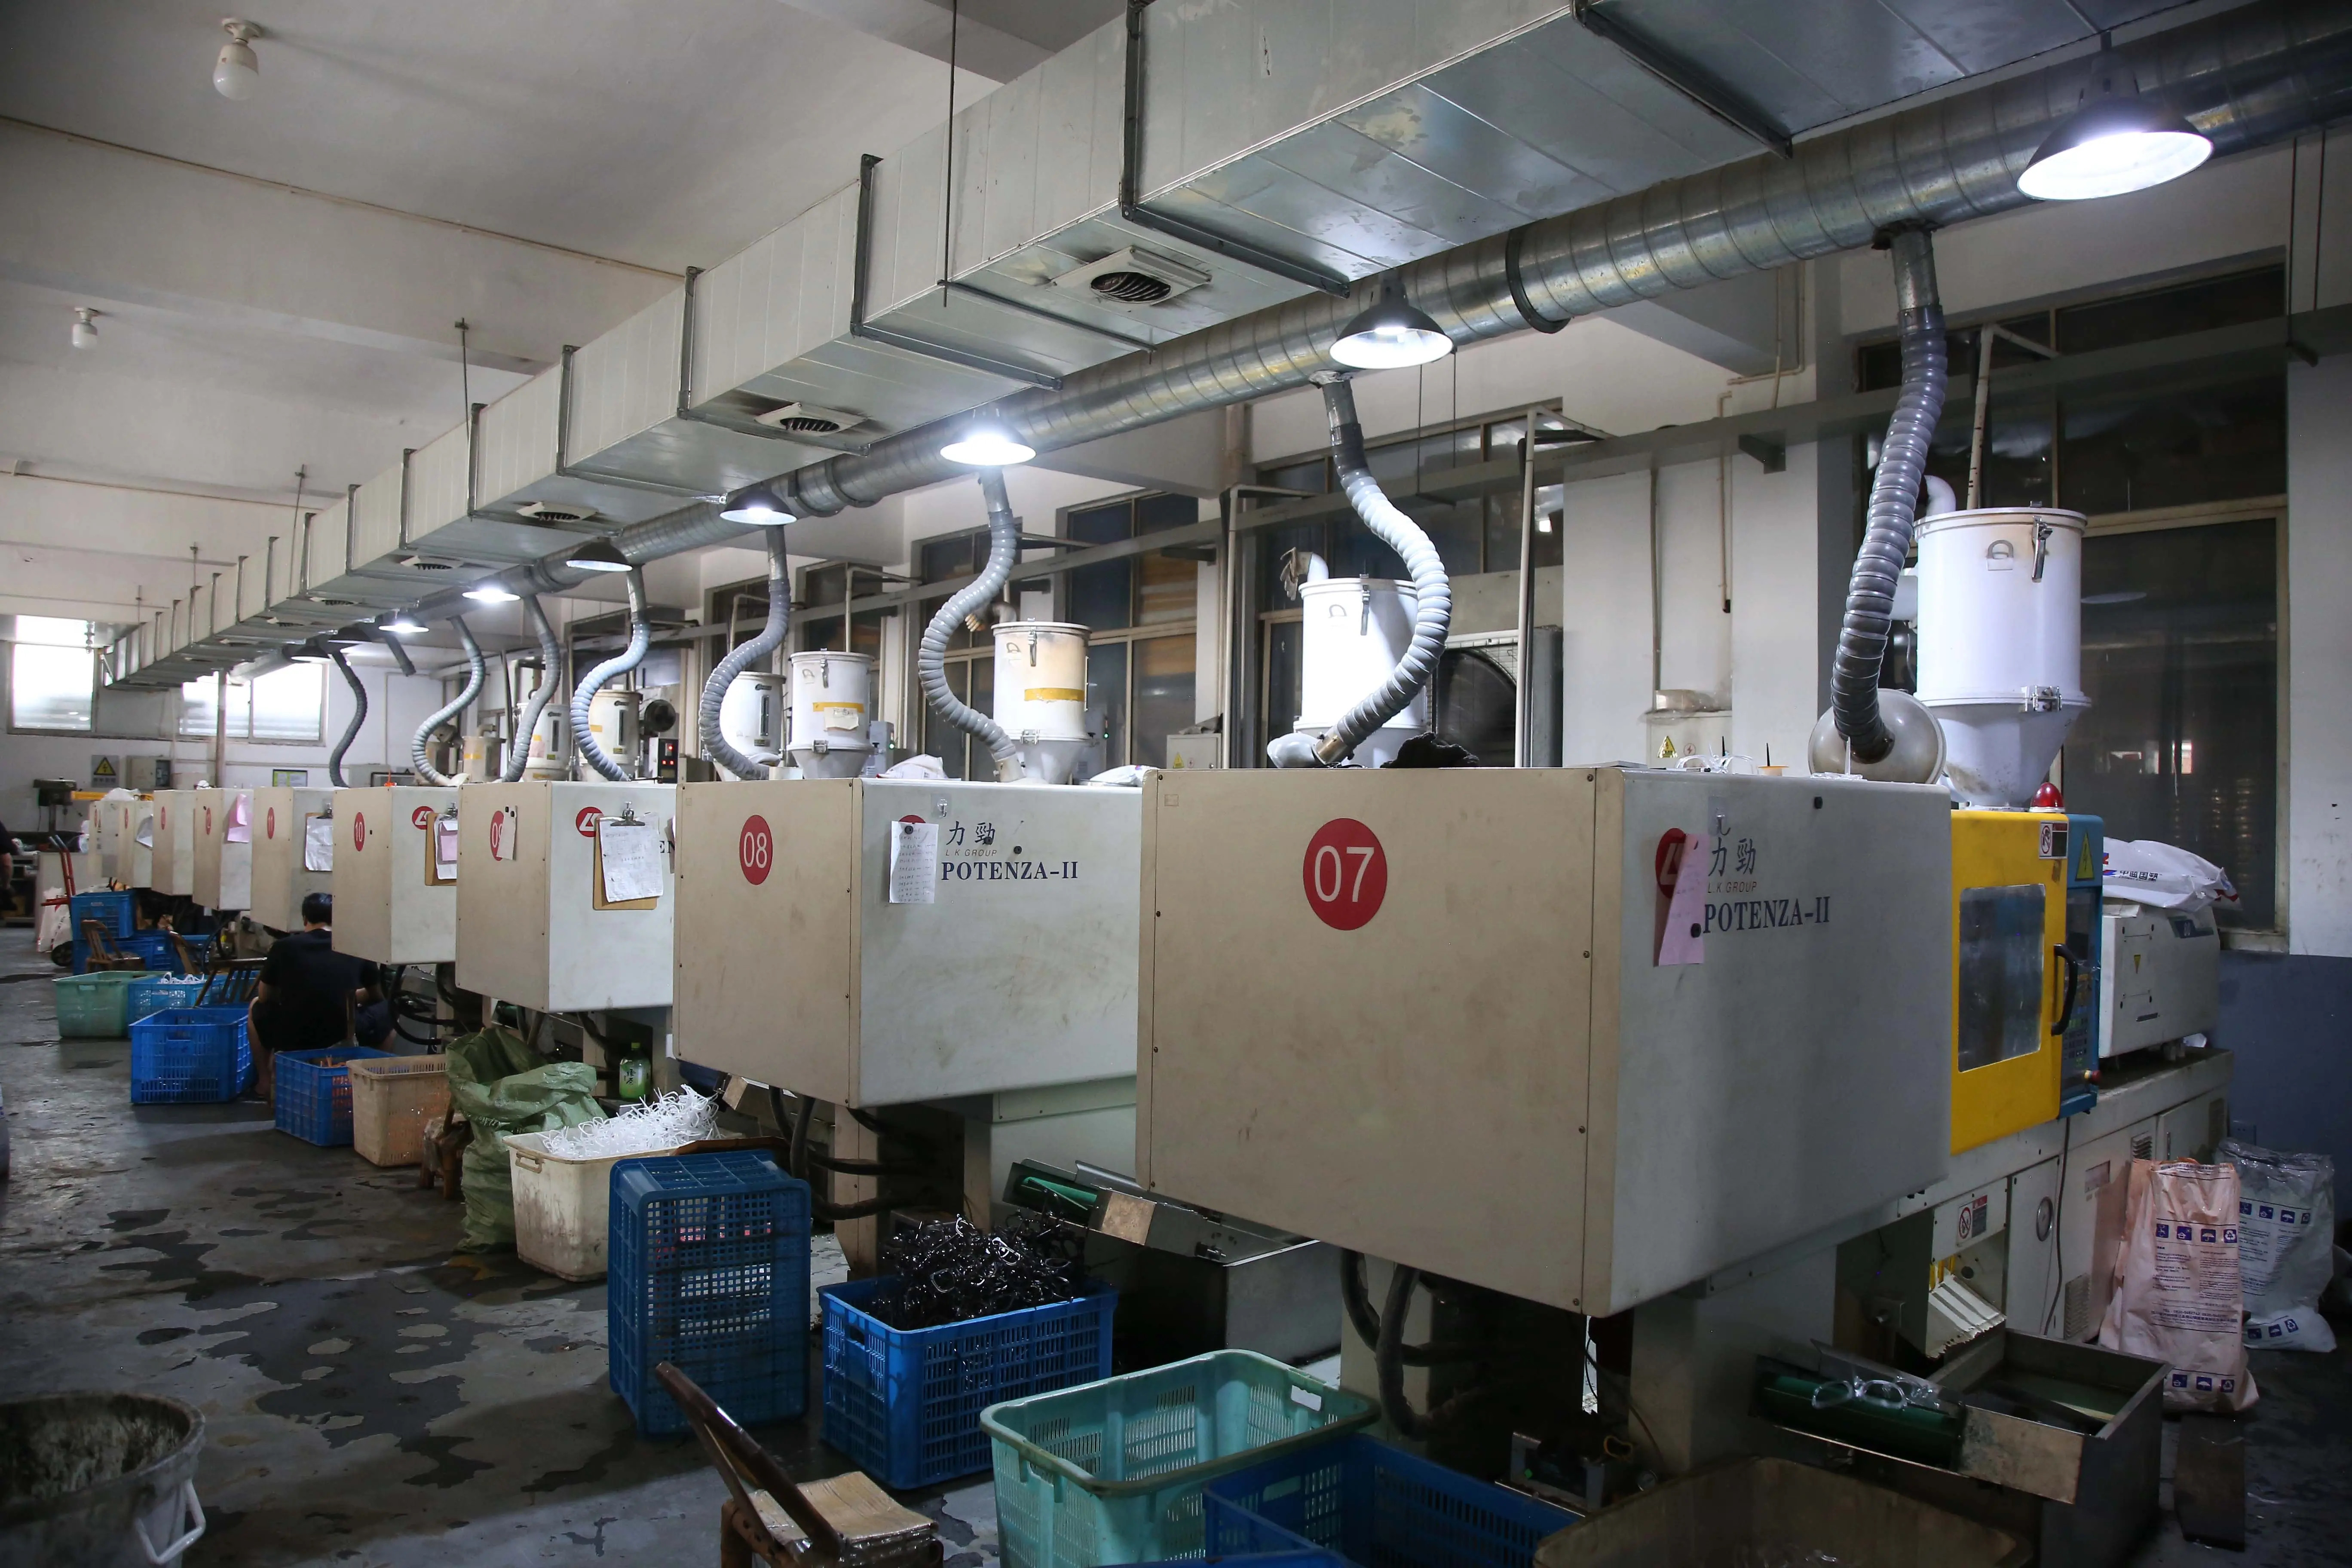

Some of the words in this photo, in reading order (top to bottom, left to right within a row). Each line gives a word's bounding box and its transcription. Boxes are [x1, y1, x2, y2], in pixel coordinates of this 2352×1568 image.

[355, 821, 363, 842] 10
[744, 832, 768, 869] 08
[1708, 836, 1757, 877] 力勁
[941, 861, 1078, 881] POTENZA-II
[1314, 845, 1375, 903] 07
[1726, 881, 1758, 893] GROUP
[1702, 896, 1831, 934] POTENZA-II
